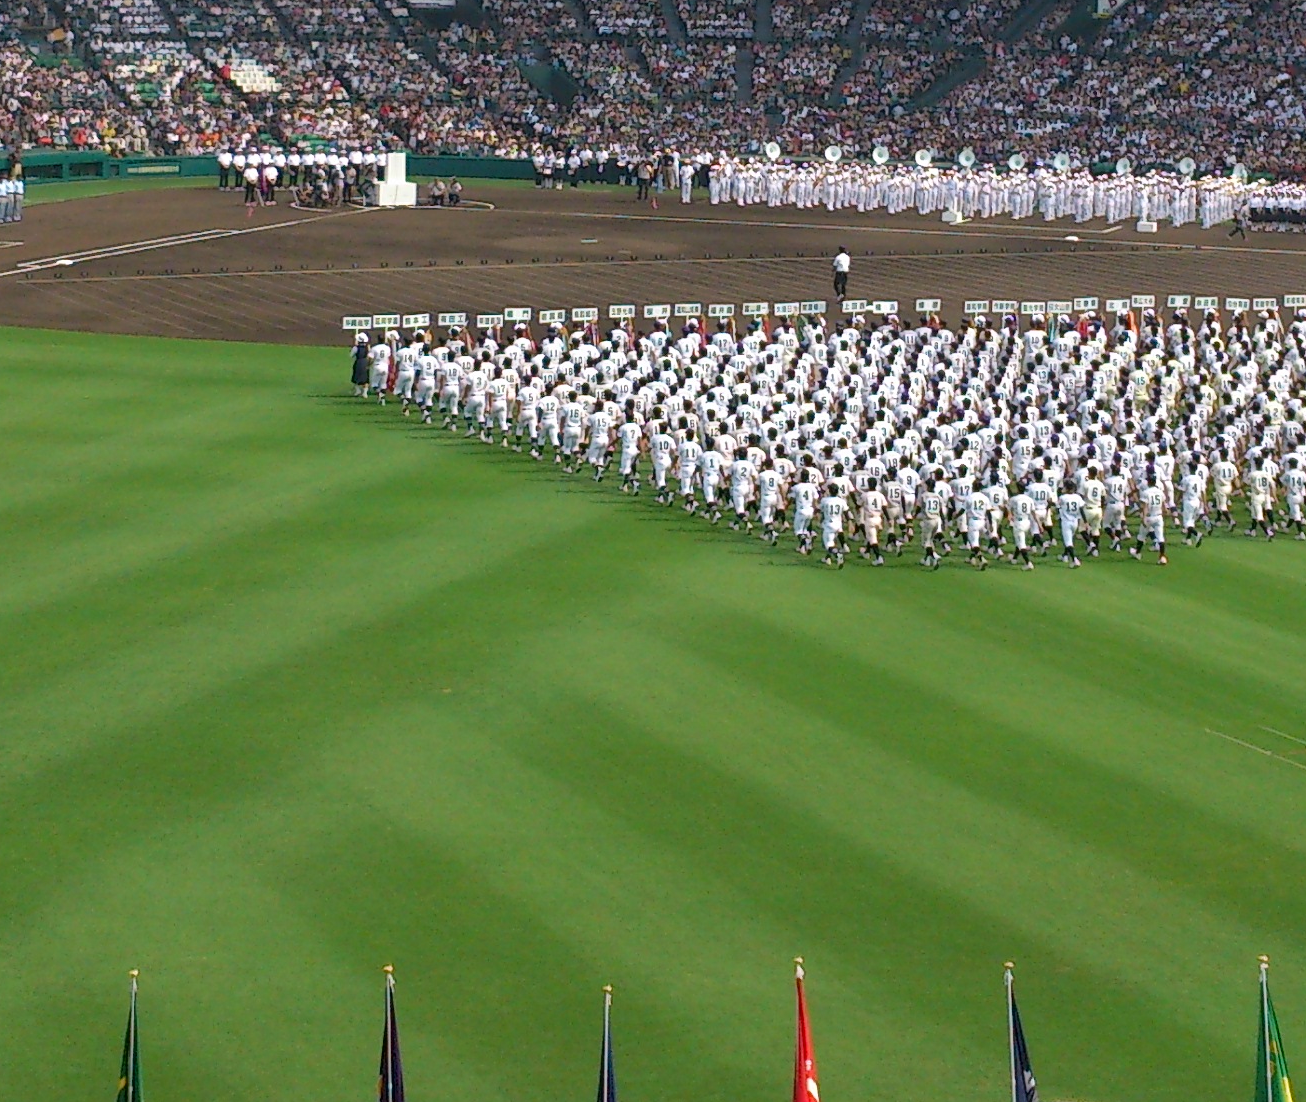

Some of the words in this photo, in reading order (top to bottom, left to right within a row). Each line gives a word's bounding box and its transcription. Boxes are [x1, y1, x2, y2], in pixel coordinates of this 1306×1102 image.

[497, 385, 505, 393] 17
[570, 409, 579, 417] 16
[829, 505, 839, 515] 13
[927, 501, 937, 510] 13
[973, 501, 984, 510] 12
[1066, 502, 1077, 512] 13
